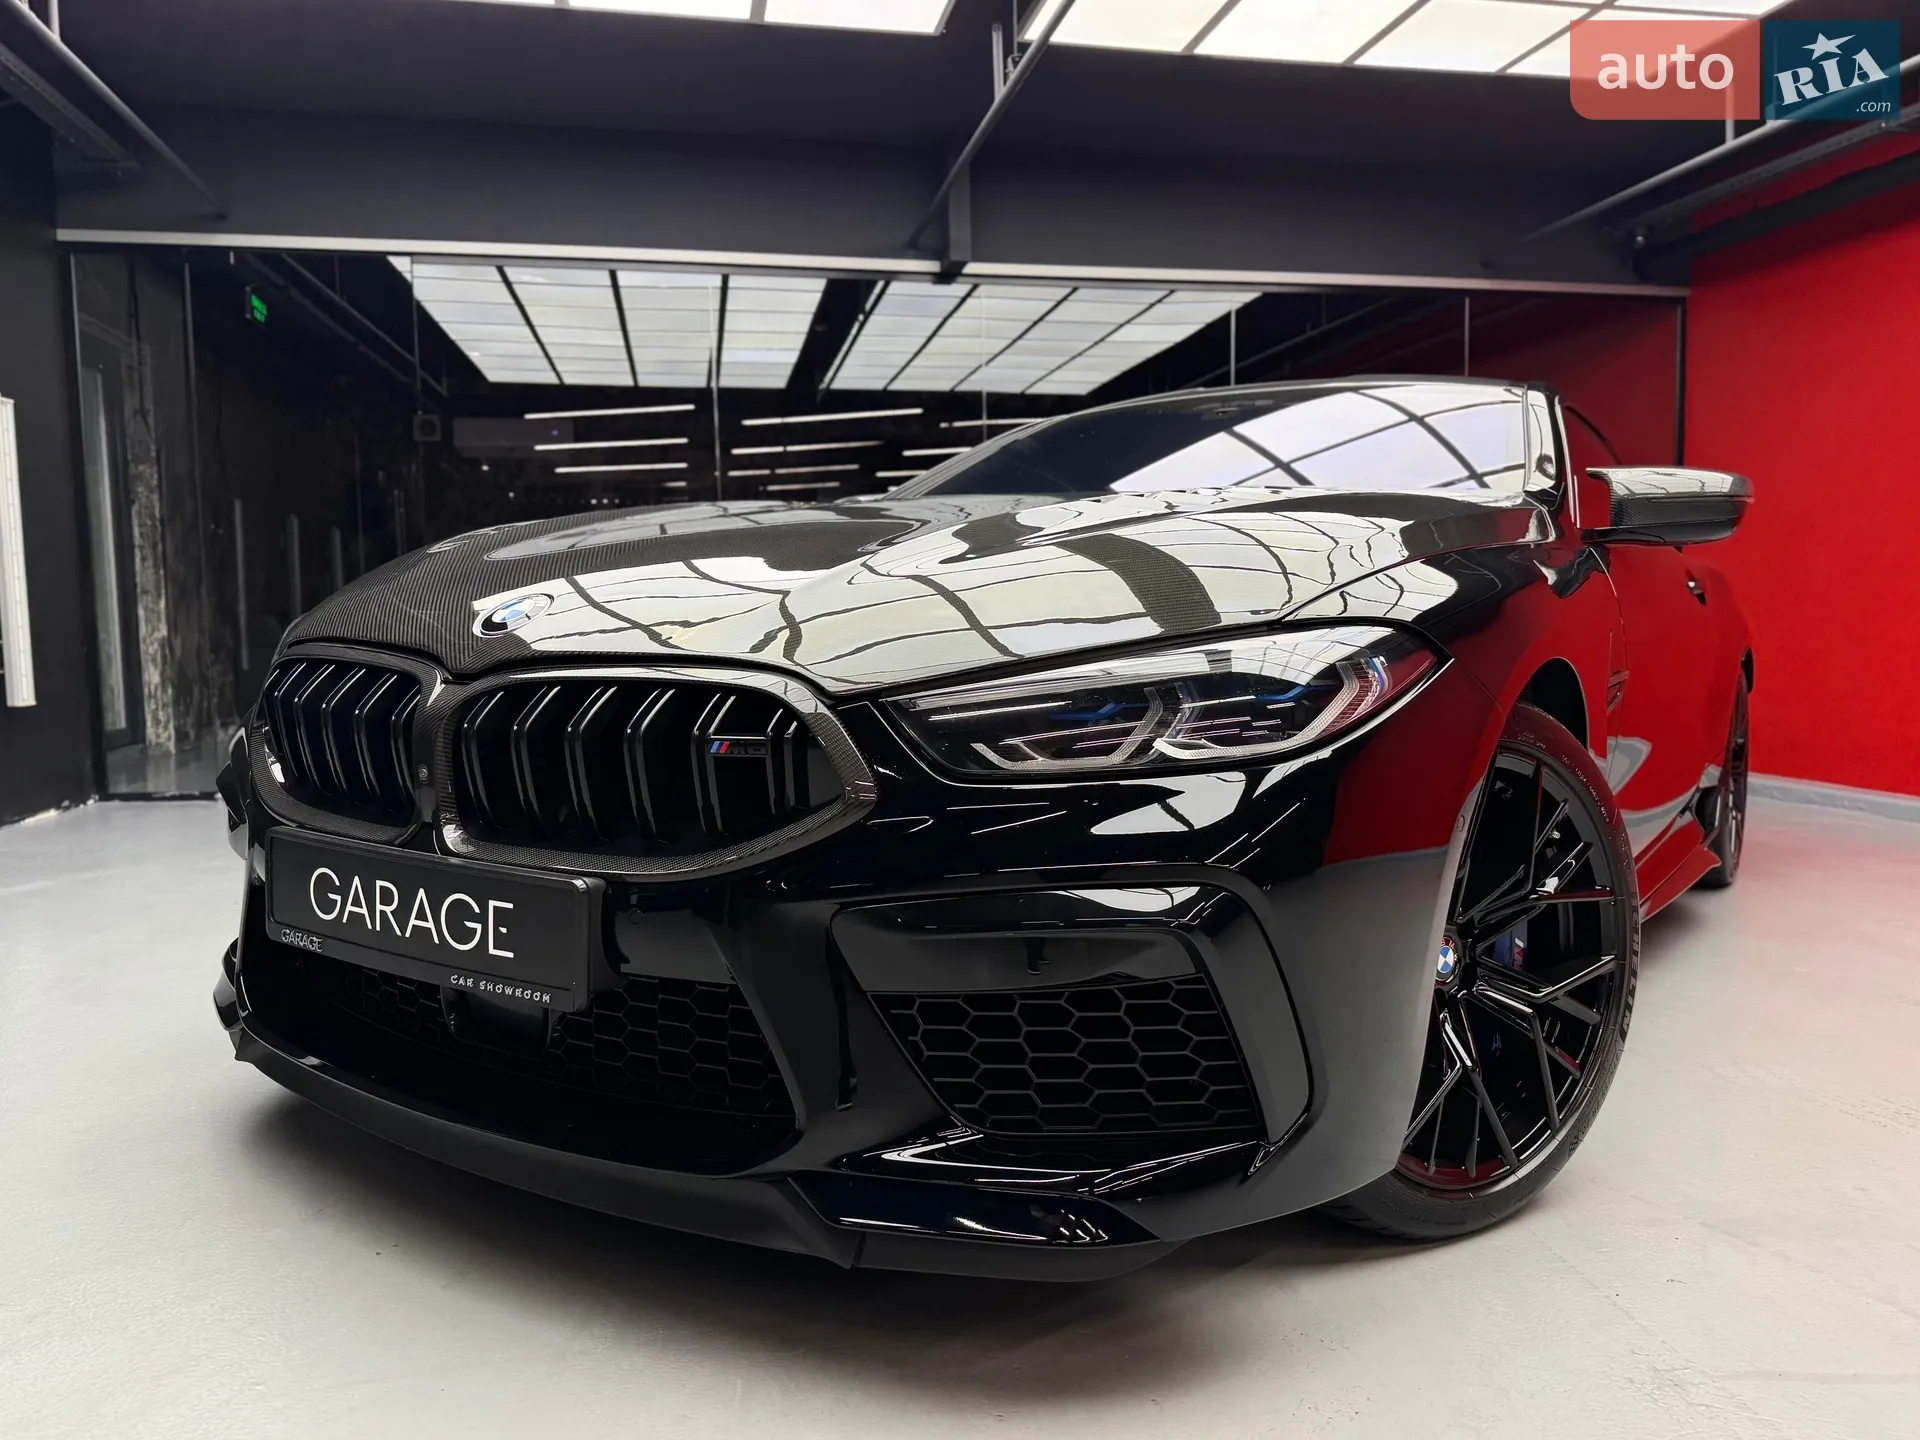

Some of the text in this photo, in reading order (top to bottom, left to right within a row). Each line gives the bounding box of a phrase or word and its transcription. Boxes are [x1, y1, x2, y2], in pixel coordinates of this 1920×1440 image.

[309, 866, 515, 958] GARAGE
[280, 928, 324, 953] GARAGE
[450, 974, 552, 1003] CAR SHOWROOM
